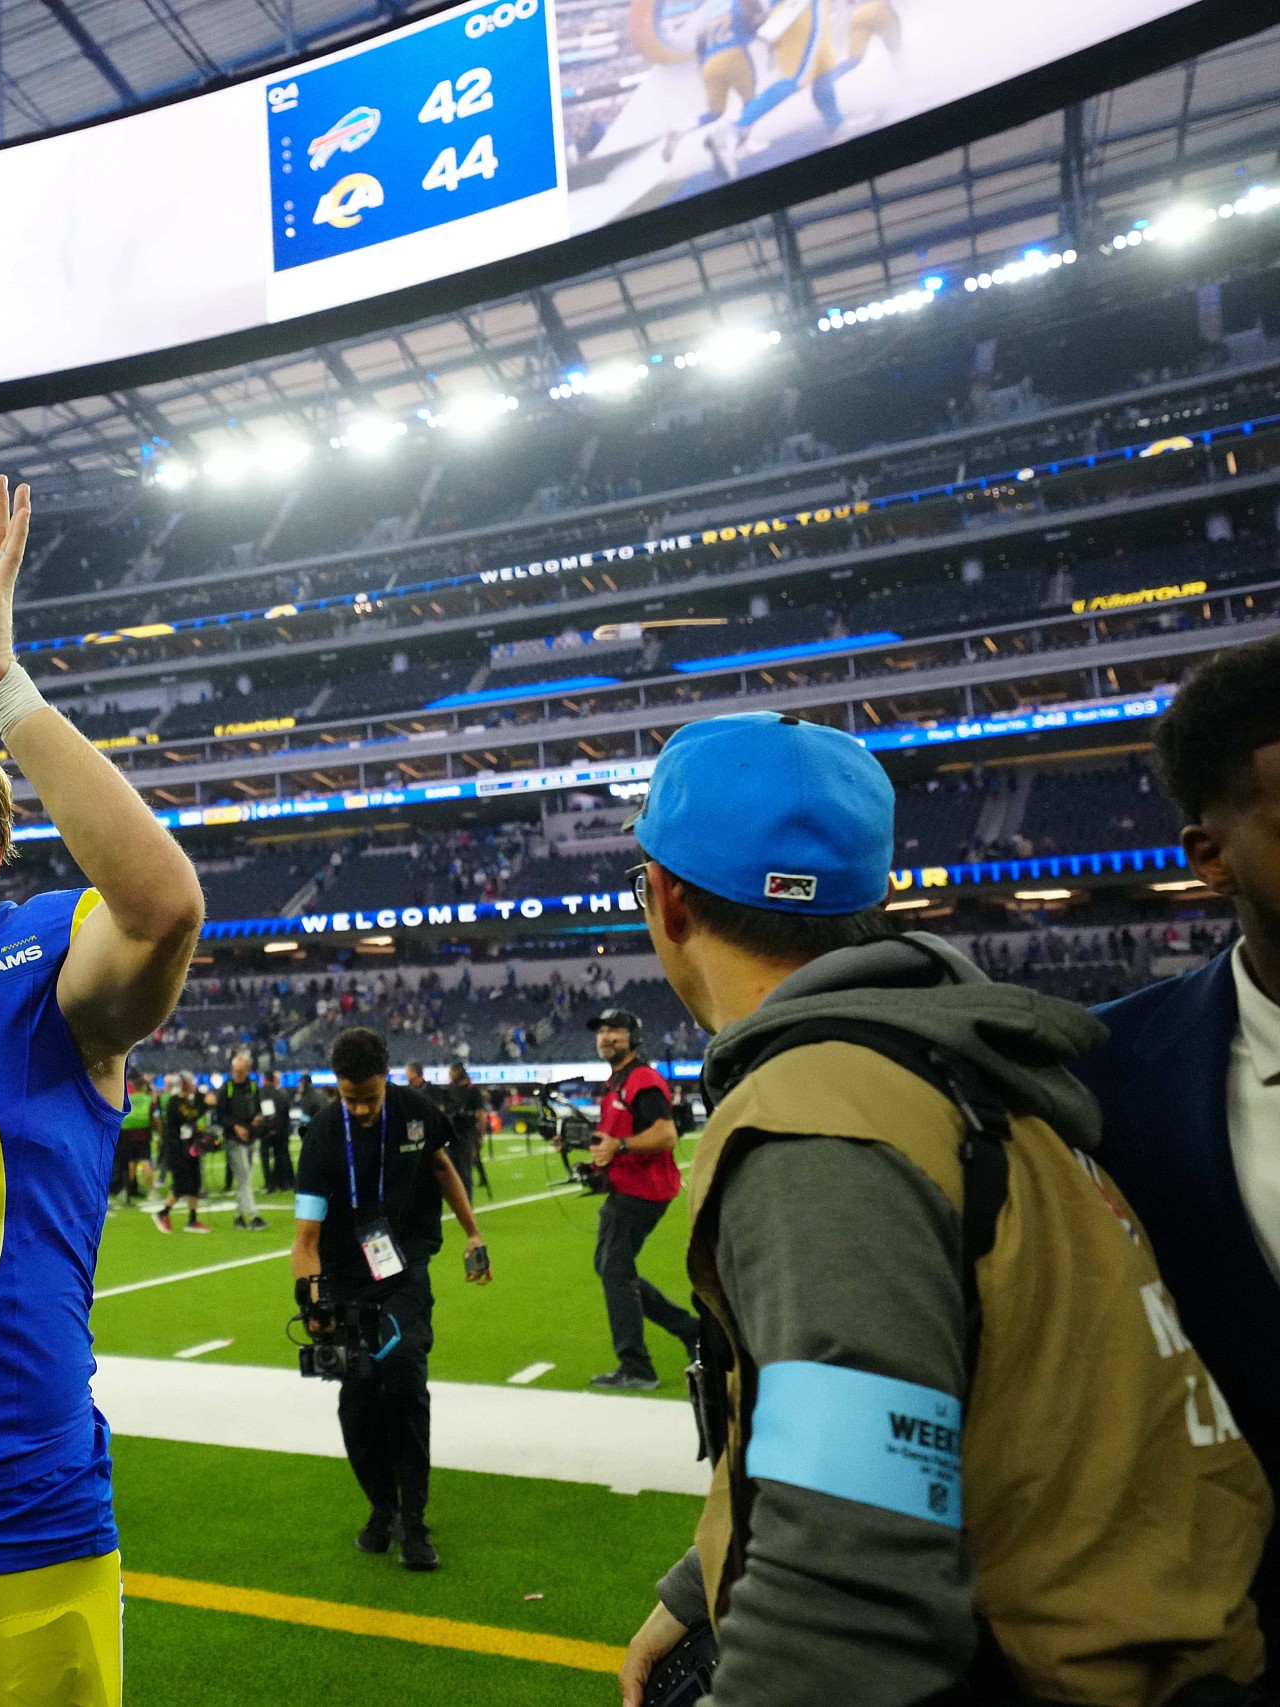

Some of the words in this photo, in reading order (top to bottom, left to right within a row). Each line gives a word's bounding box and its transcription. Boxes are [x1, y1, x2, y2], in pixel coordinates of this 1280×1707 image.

[465, 0, 539, 40] 0:00
[417, 67, 495, 126] 42
[421, 135, 499, 192] 44
[480, 553, 594, 585] WELCOME
[603, 546, 635, 563] TO
[644, 535, 693, 555] THE
[702, 518, 788, 545] ROYAL
[795, 500, 871, 527] TOUR
[301, 903, 478, 934] WELCOME
[495, 899, 544, 919] TO
[561, 891, 640, 915] THE
[892, 866, 949, 891] UR
